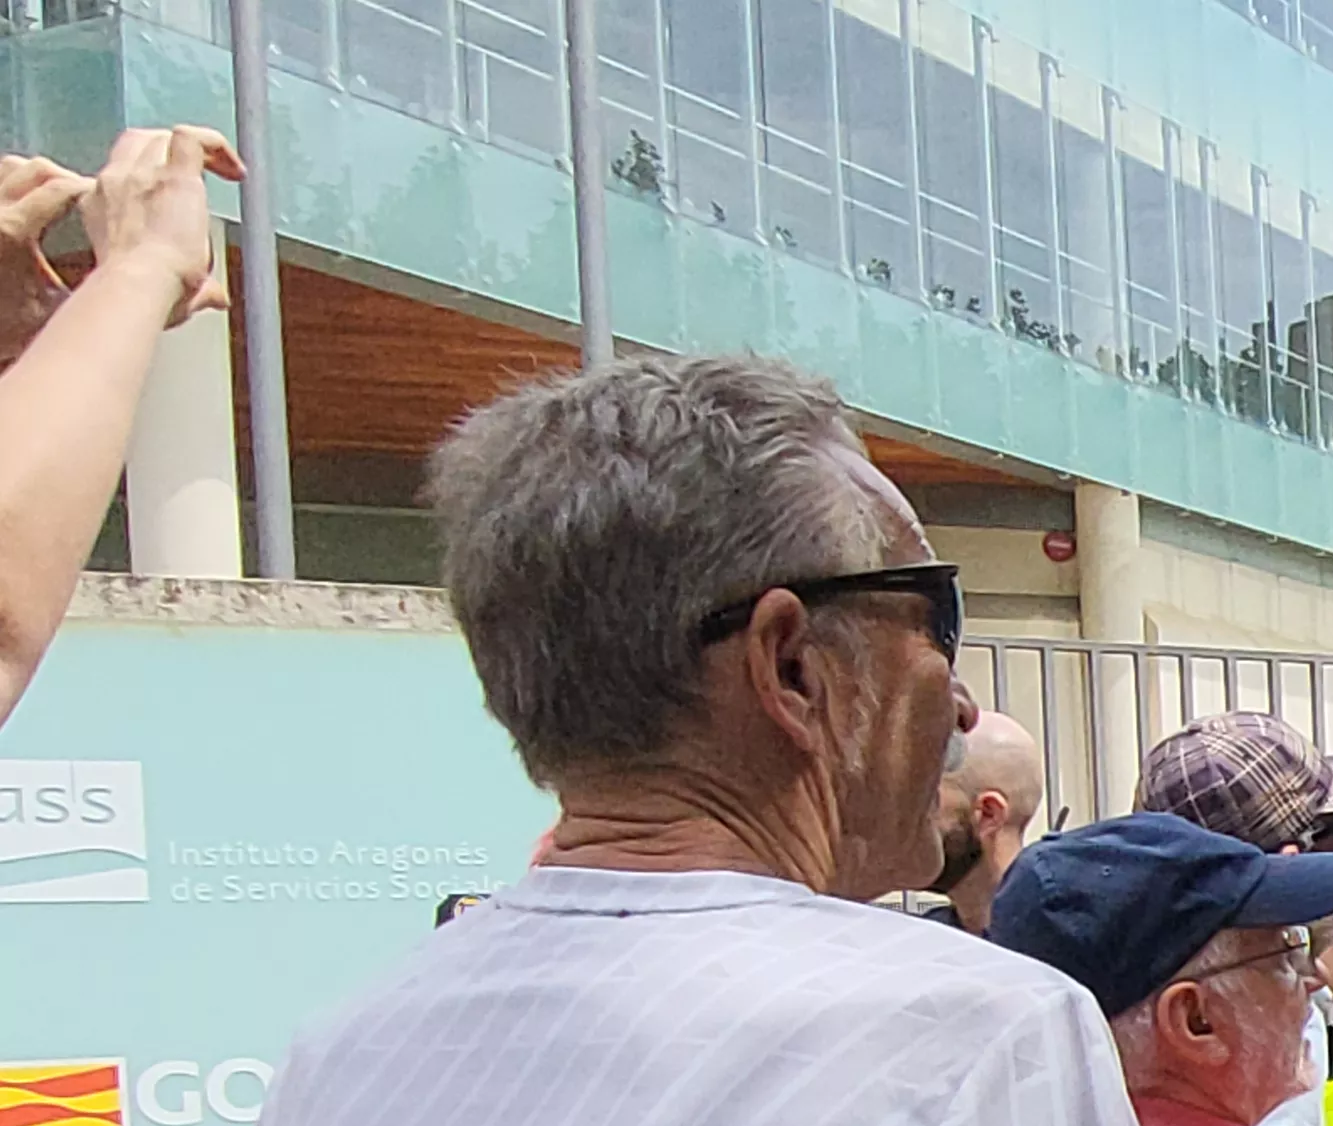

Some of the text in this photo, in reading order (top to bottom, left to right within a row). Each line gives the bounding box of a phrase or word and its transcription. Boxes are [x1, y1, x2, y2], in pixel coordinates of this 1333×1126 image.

[168, 839, 490, 873] Instituto Aragonés
[170, 876, 214, 902] de
[222, 874, 381, 901] Servicios
